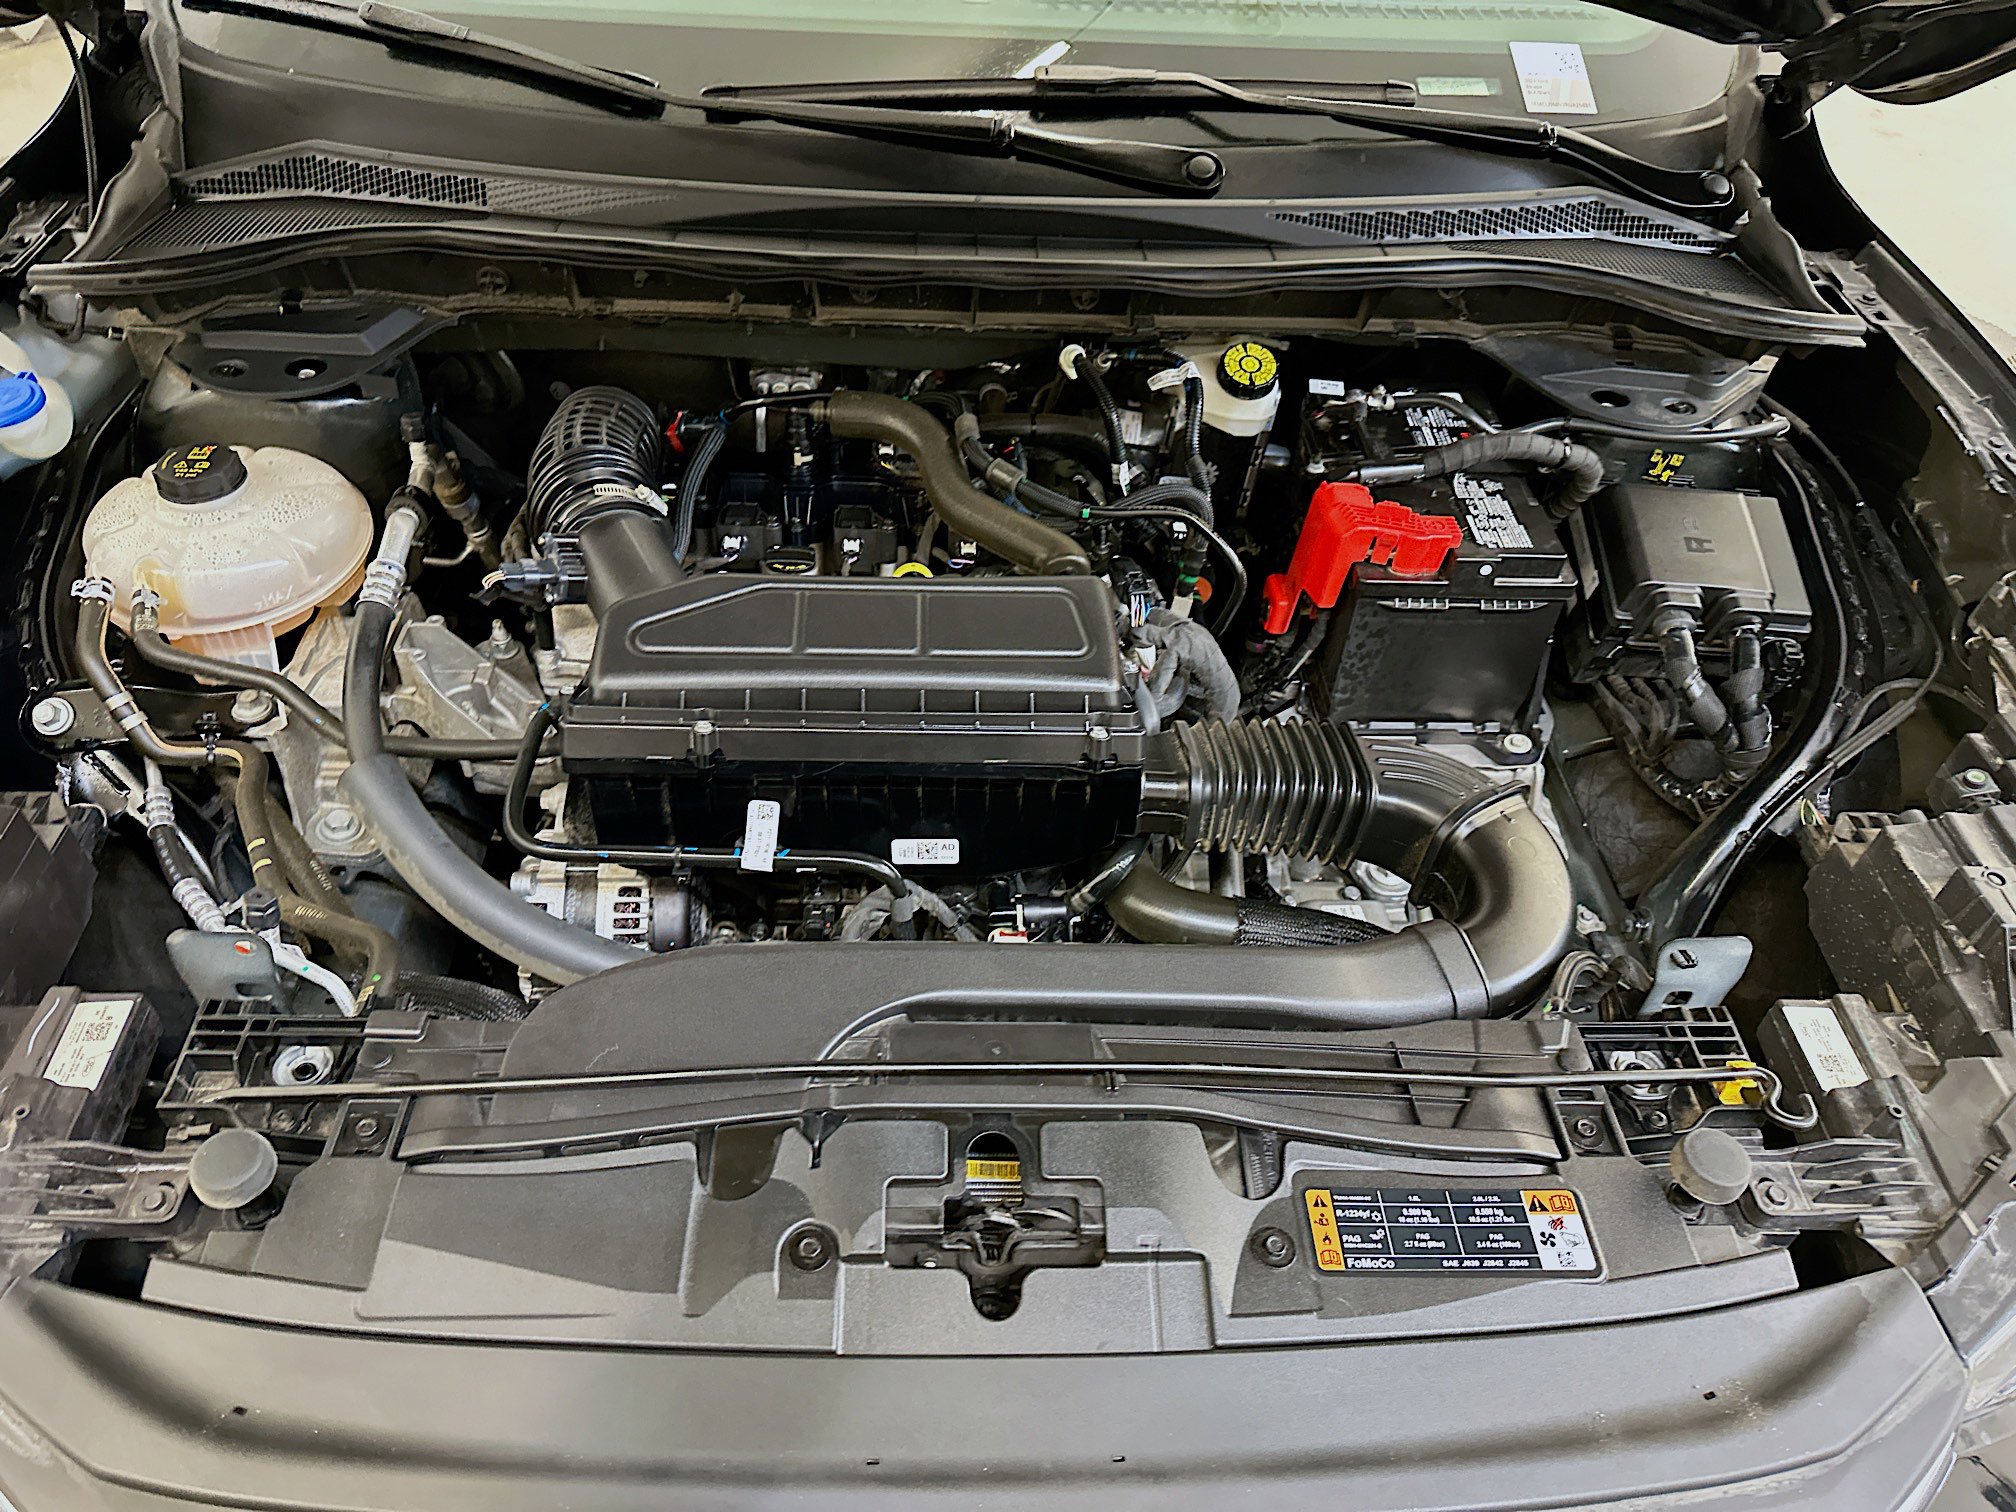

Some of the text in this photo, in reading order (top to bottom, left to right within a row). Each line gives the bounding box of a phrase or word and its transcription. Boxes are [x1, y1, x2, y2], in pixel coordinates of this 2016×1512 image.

[1336, 1209, 1371, 1219] R-1234yf
[1342, 1234, 1362, 1243] PAG
[1346, 1257, 1396, 1269] FoMoCo
